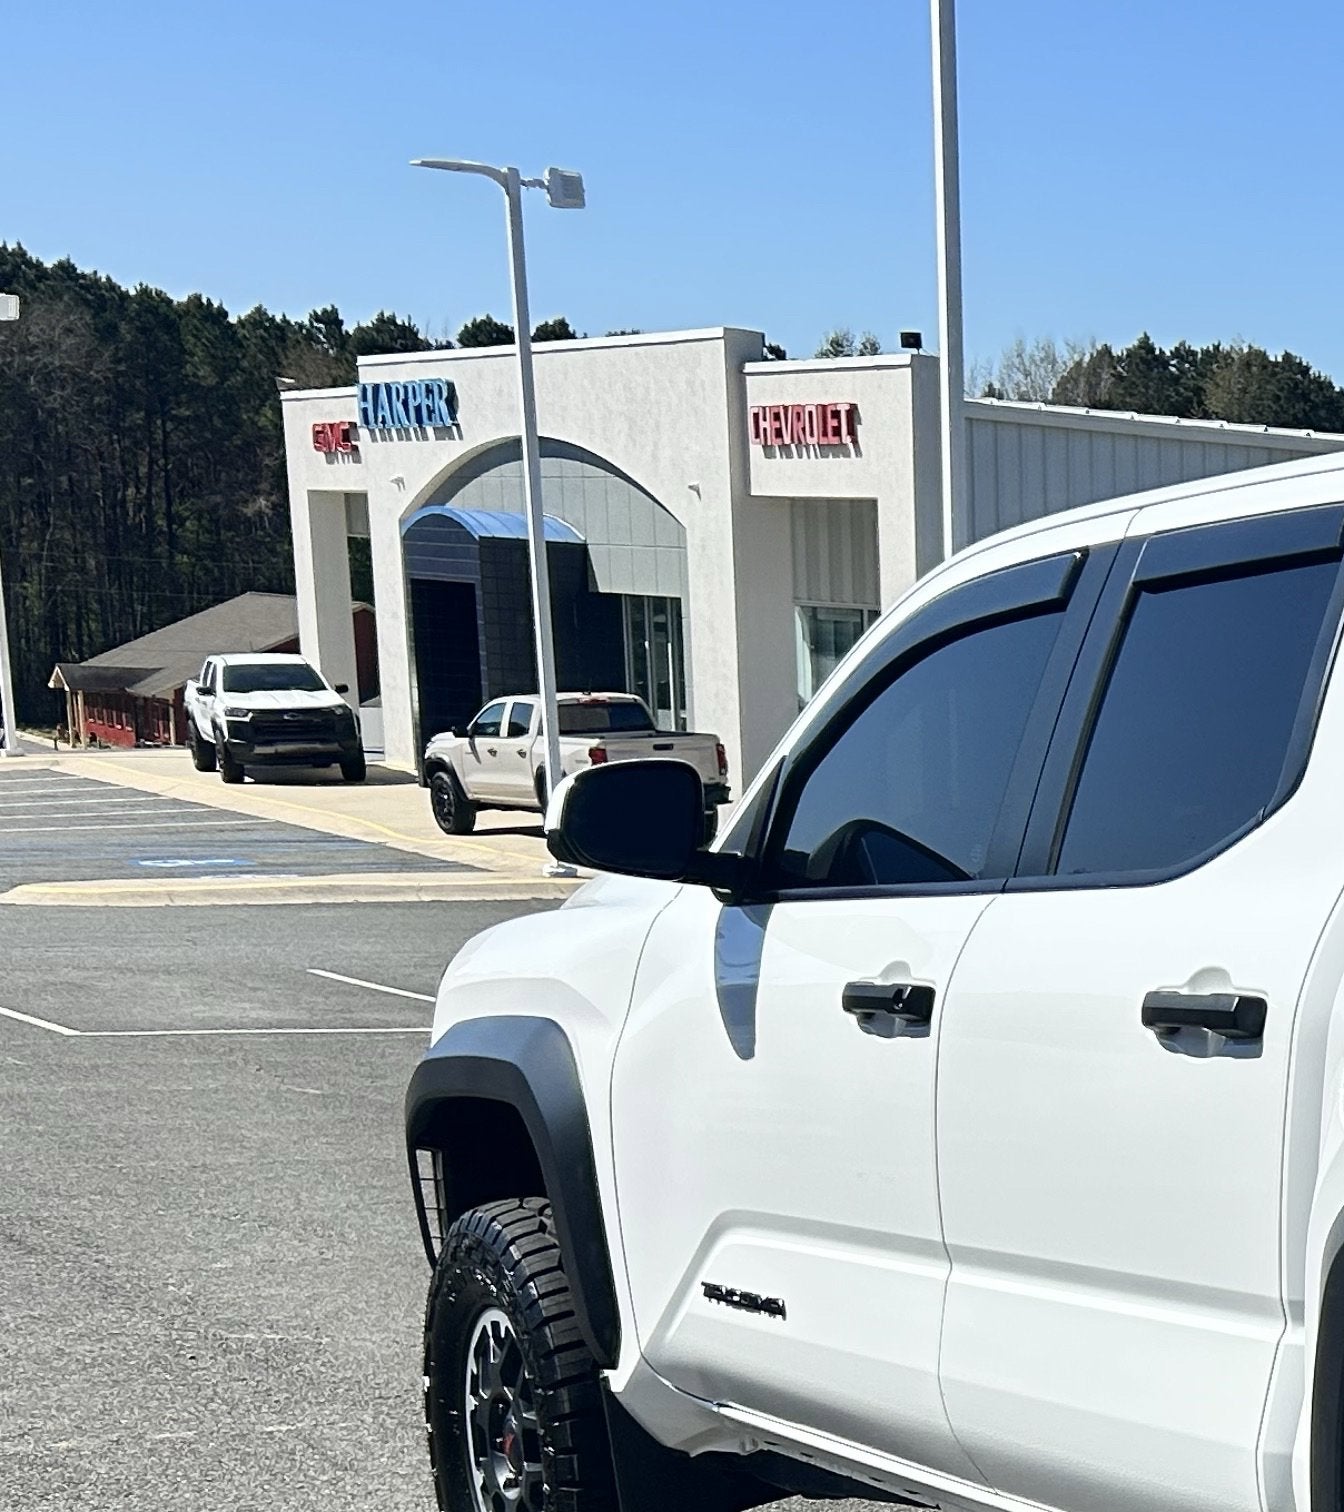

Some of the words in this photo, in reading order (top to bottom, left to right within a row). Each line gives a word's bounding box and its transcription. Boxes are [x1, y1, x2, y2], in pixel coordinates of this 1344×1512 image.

[358, 379, 453, 428] HARPER
[312, 421, 357, 453] GMC
[750, 404, 851, 446] CHEVROLET
